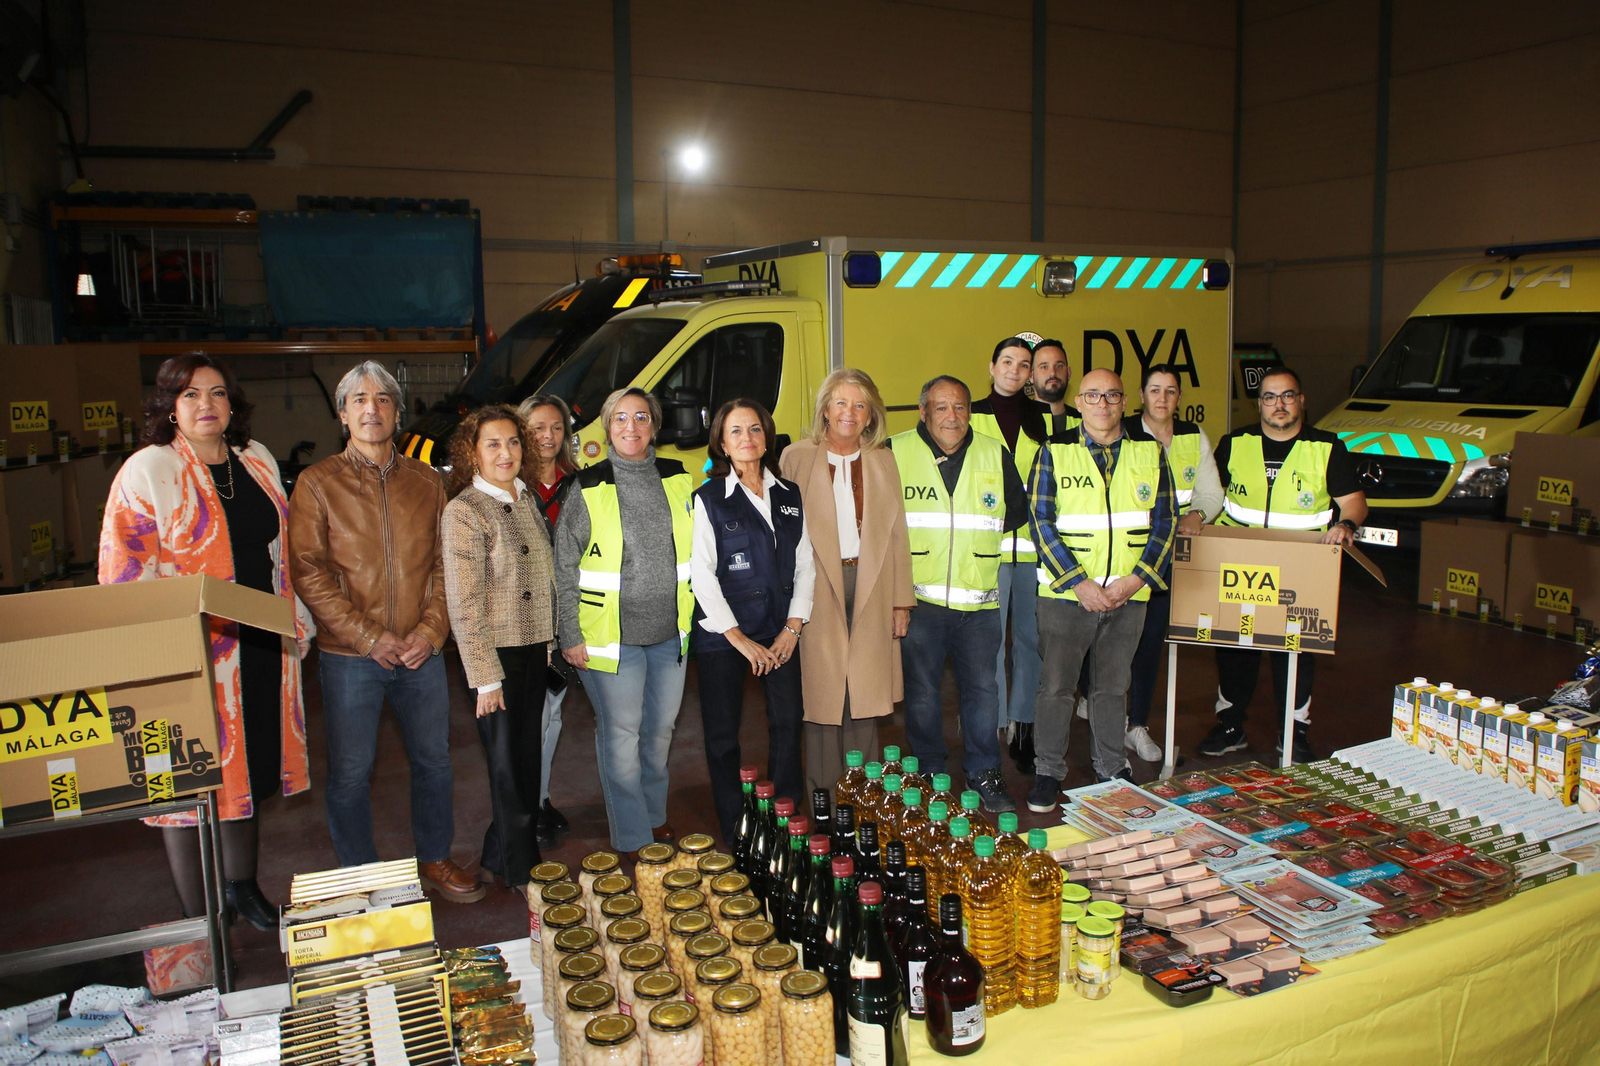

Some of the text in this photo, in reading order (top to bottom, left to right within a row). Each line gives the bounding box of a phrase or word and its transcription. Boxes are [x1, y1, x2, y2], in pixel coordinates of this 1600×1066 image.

[738, 260, 781, 296] DYA
[1457, 265, 1574, 293] DYA
[1083, 329, 1200, 388] DYA
[12, 406, 46, 421] DYA
[84, 405, 115, 420] DYA
[1061, 476, 1094, 489] DYA
[1540, 481, 1571, 496] DYA
[904, 486, 938, 501] DYA
[31, 525, 50, 543] DYA
[1223, 569, 1276, 591] DYA
[1449, 572, 1477, 587] DYA
[1226, 590, 1272, 602] MÁLAGA
[1538, 587, 1570, 603] DYA
[1287, 606, 1319, 616] MOVING
[1241, 614, 1249, 635] DYA
[1198, 628, 1207, 641] YA
[0, 690, 103, 734] DYA
[110, 717, 131, 727] oving
[6, 727, 100, 754] MÁLAGA
[143, 719, 161, 755] DYA
[52, 774, 70, 811] DYA
